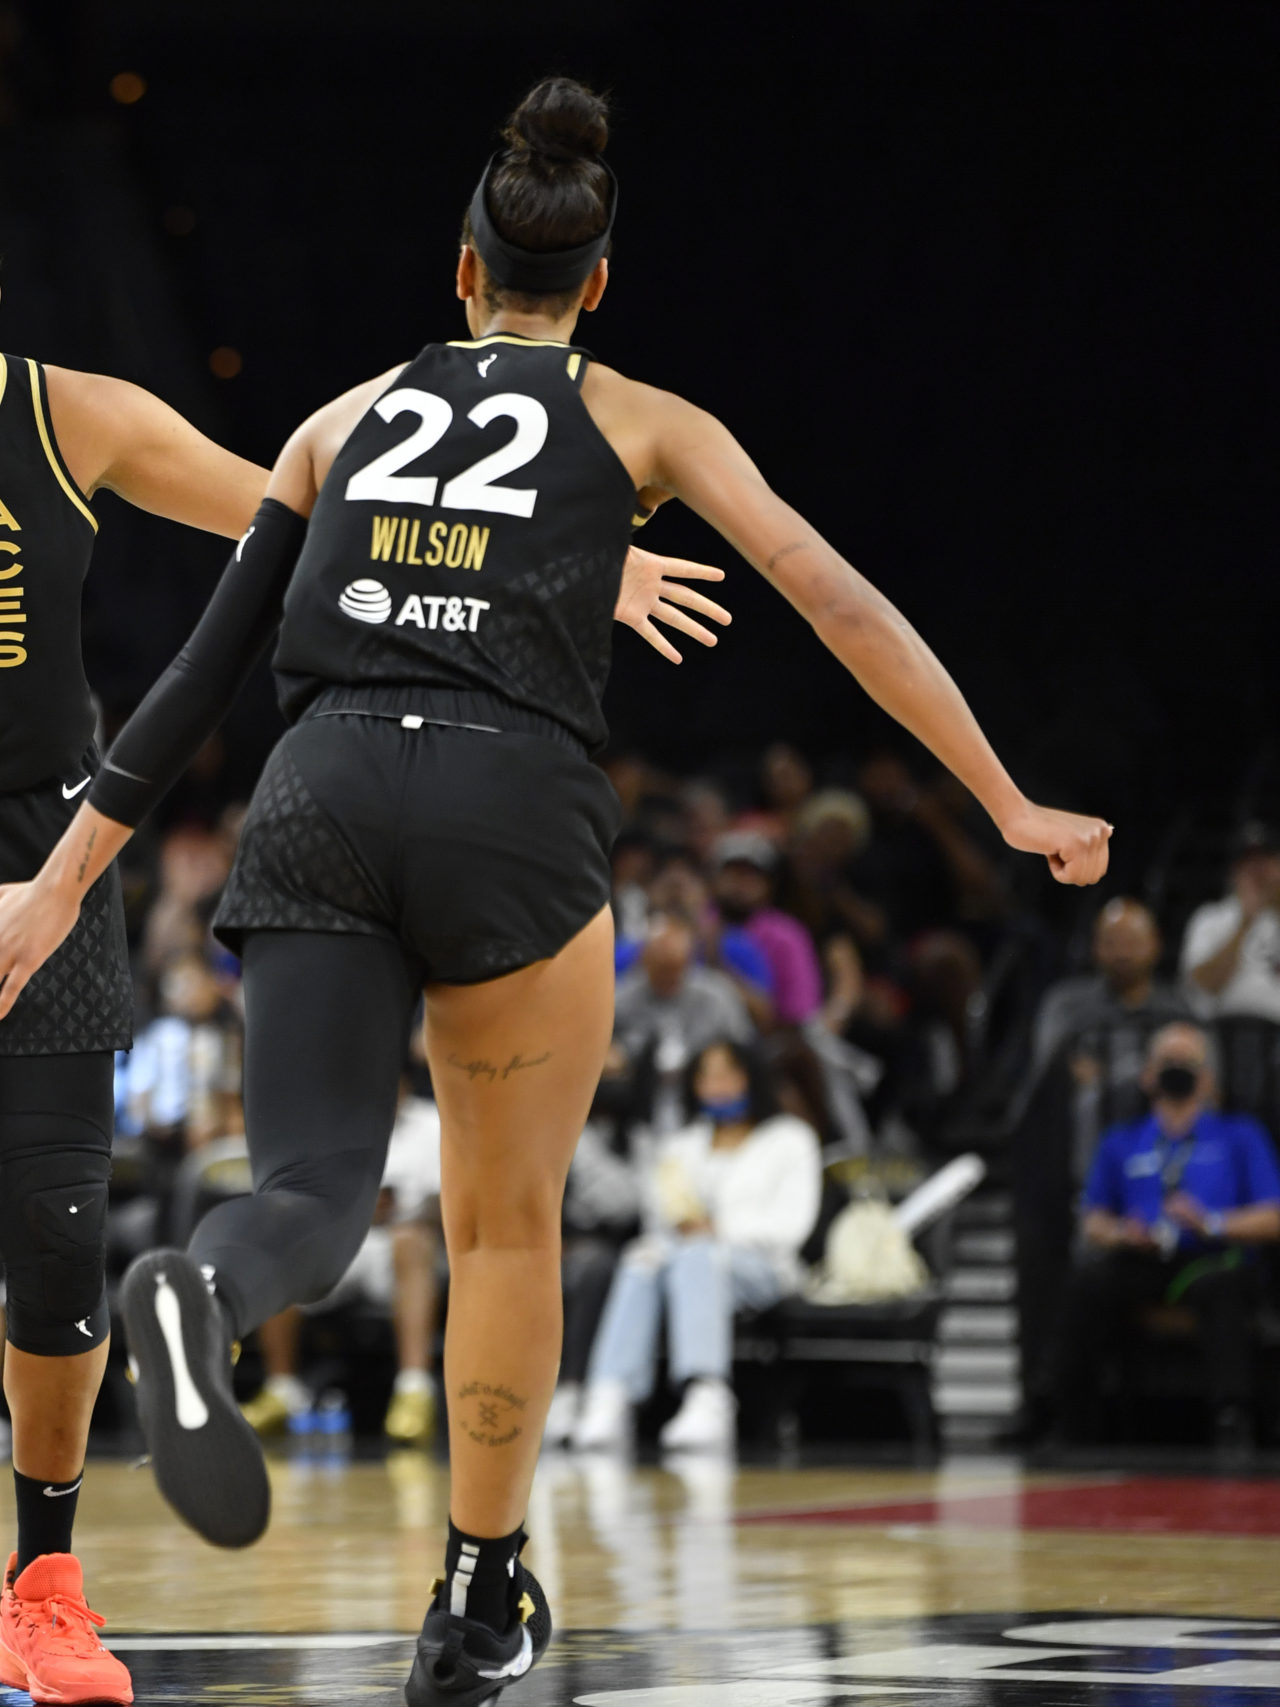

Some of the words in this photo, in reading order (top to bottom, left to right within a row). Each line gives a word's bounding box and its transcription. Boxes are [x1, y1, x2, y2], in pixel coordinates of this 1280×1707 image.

[345, 388, 549, 518] 22
[370, 515, 490, 571] WILSON
[395, 594, 490, 632] AT&T
